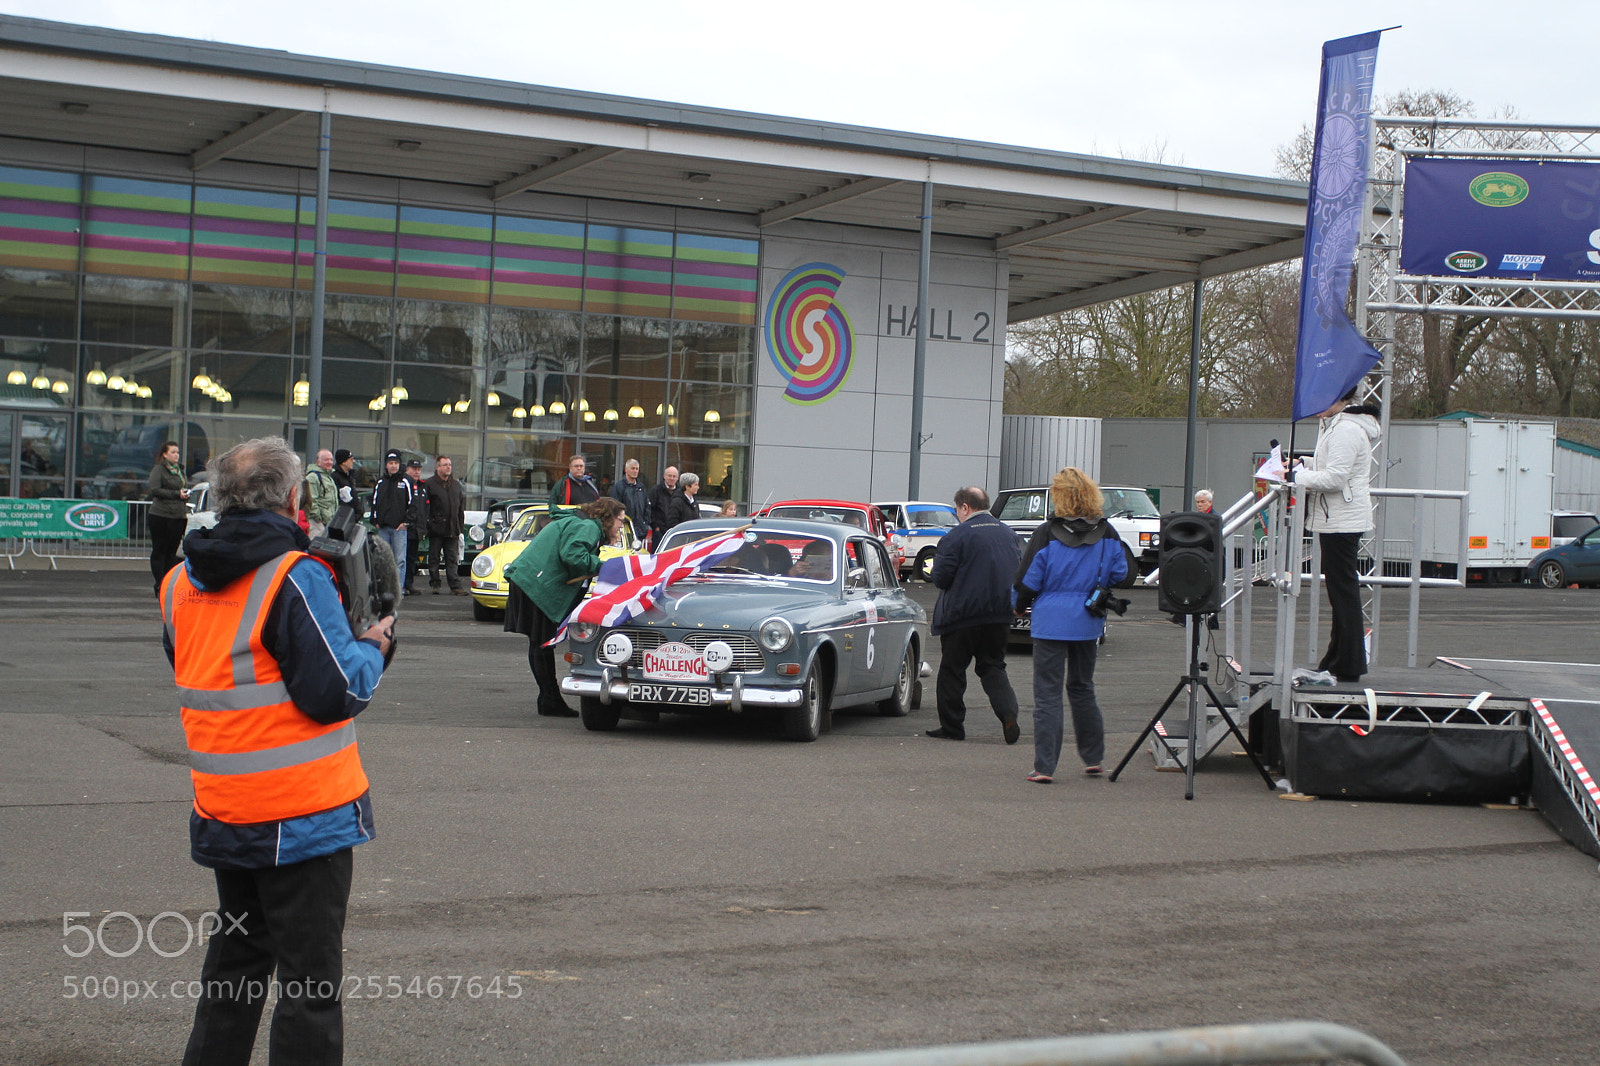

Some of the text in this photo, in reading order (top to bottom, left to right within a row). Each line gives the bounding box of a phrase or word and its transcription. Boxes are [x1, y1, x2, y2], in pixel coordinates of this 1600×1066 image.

[1505, 255, 1544, 263] MOTORS
[973, 311, 990, 342] 2
[1028, 495, 1041, 513] 19
[866, 626, 875, 670] 6
[630, 685, 710, 704] PRX 775B
